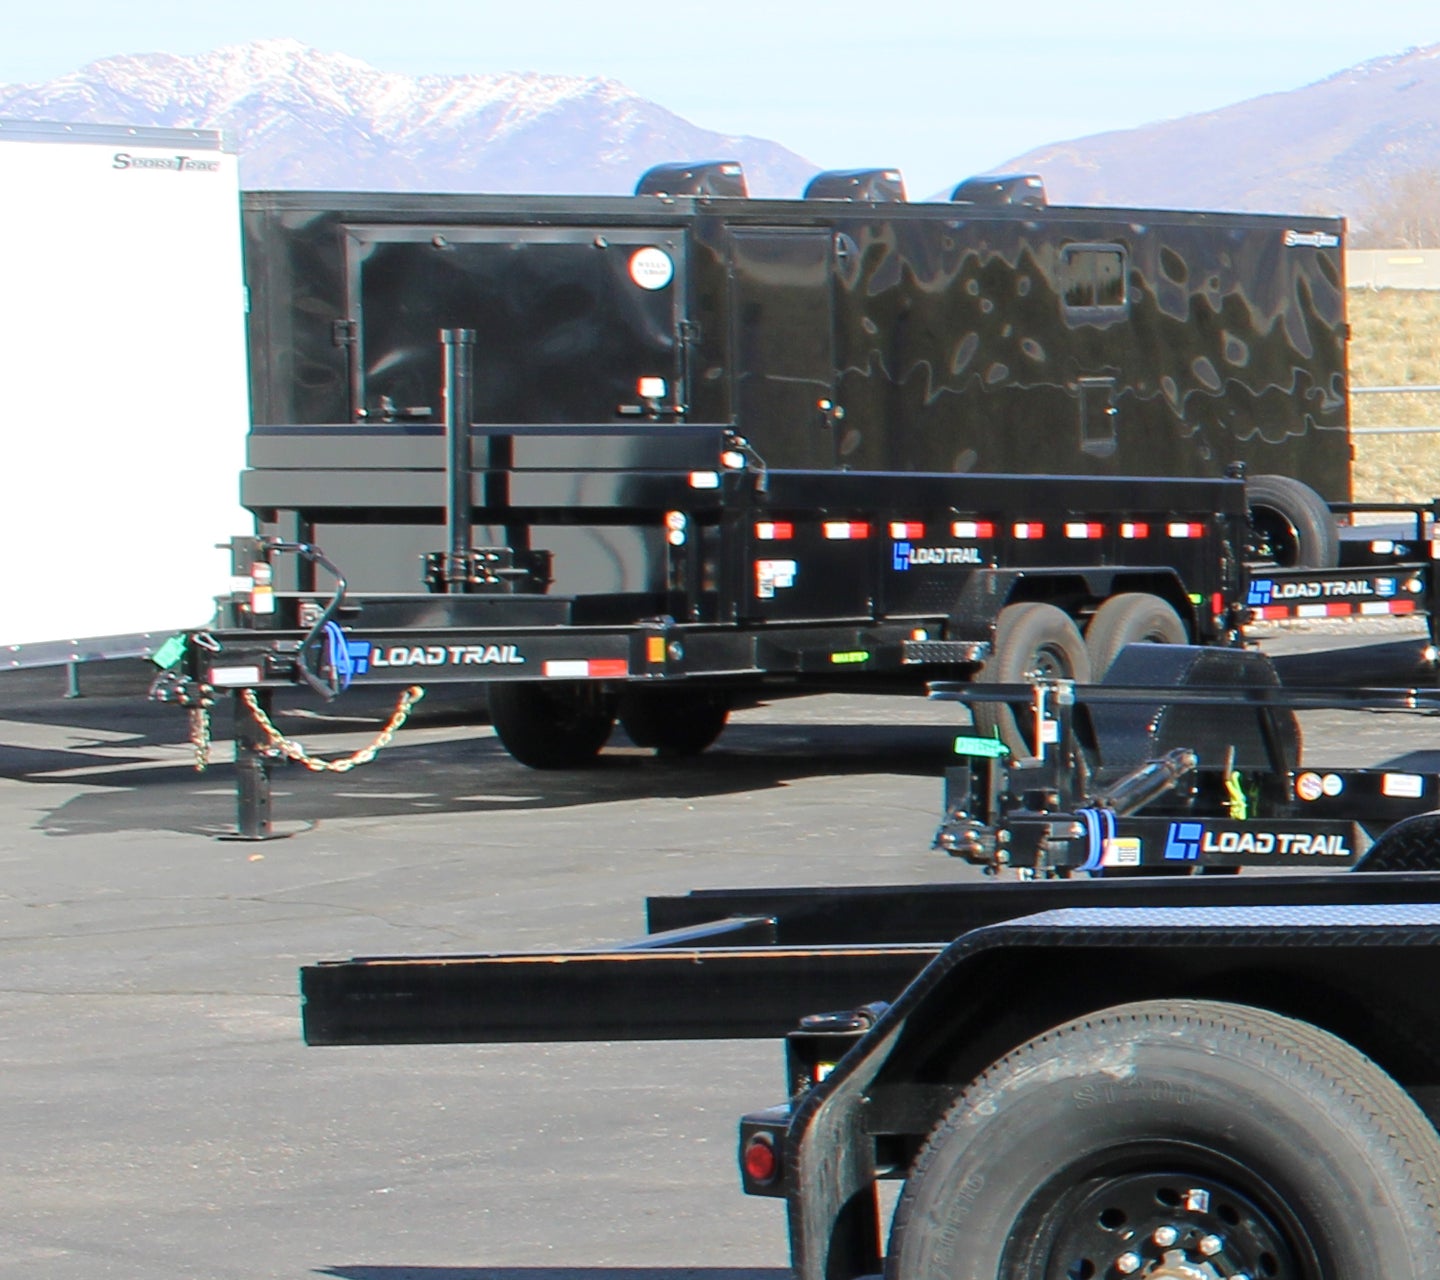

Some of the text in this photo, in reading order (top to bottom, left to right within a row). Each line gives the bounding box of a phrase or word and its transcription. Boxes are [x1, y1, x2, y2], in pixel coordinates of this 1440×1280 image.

[909, 547, 982, 565] LOAD TRAIL
[1272, 582, 1322, 599] LOAD
[1322, 580, 1374, 596] TRAIL
[371, 644, 526, 667] LOAD TRAIL
[1203, 831, 1350, 856] LOAD TRAIL
